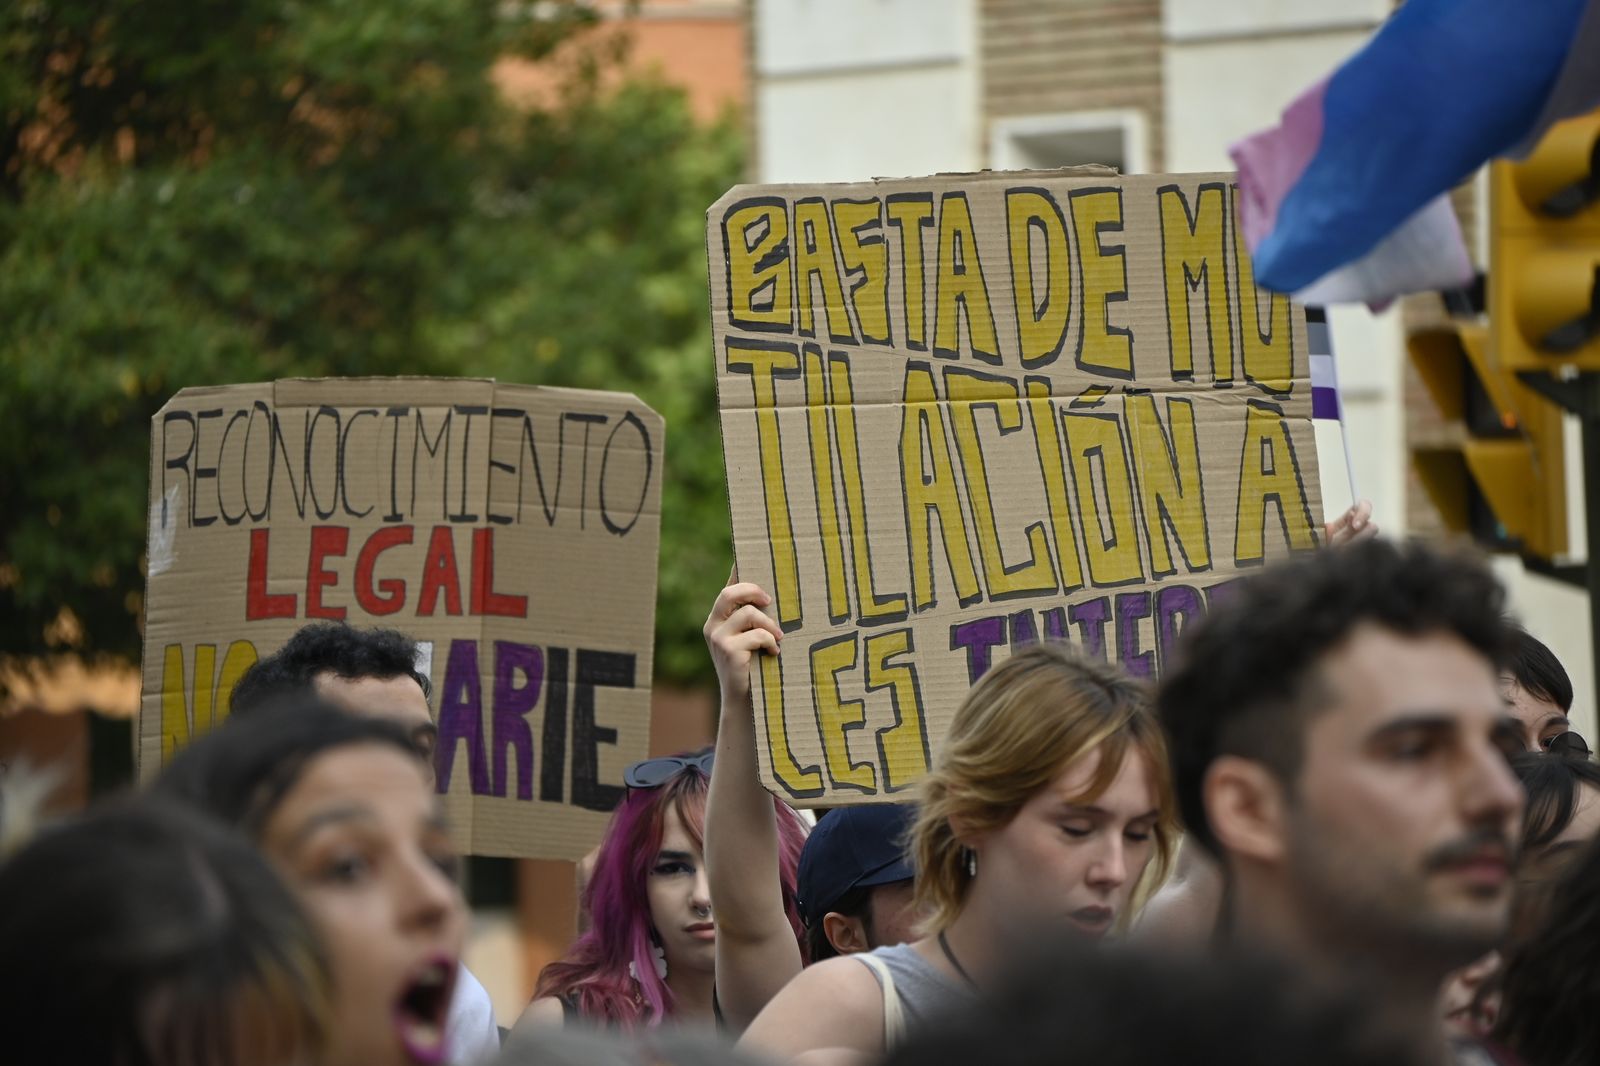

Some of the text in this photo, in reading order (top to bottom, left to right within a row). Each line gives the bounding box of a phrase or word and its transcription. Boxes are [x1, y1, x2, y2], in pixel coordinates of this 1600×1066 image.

[722, 190, 1001, 365] BASTA
[1005, 185, 1134, 380] DE
[162, 401, 652, 537] RECONOCIMIENTO
[726, 336, 1320, 631] TILACIÓN A
[245, 525, 529, 621] LEGAL
[759, 627, 932, 798] LES
